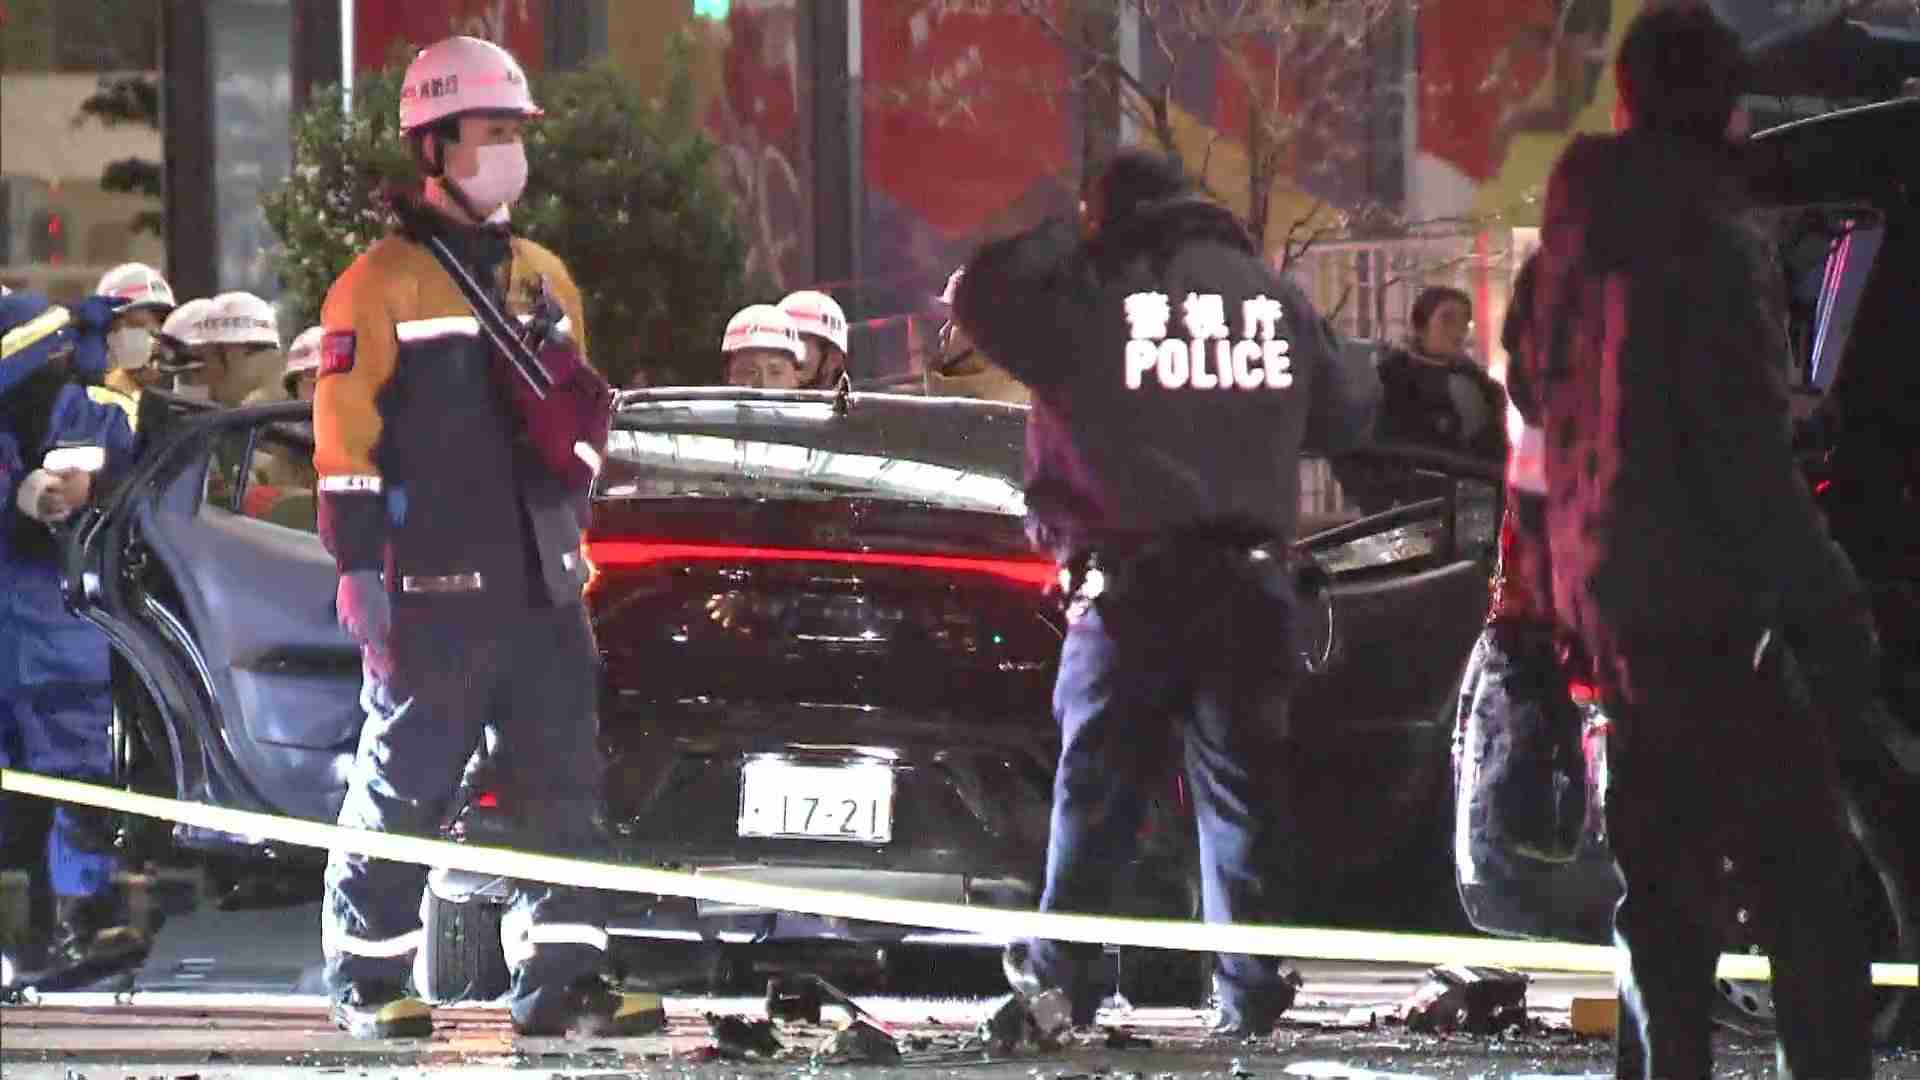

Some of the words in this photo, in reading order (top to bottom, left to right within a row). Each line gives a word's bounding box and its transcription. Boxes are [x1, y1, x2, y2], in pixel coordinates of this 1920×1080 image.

[1123, 291, 1283, 339] 警視庁
[1124, 338, 1293, 390] POLICE
[783, 795, 877, 834] 17-21
